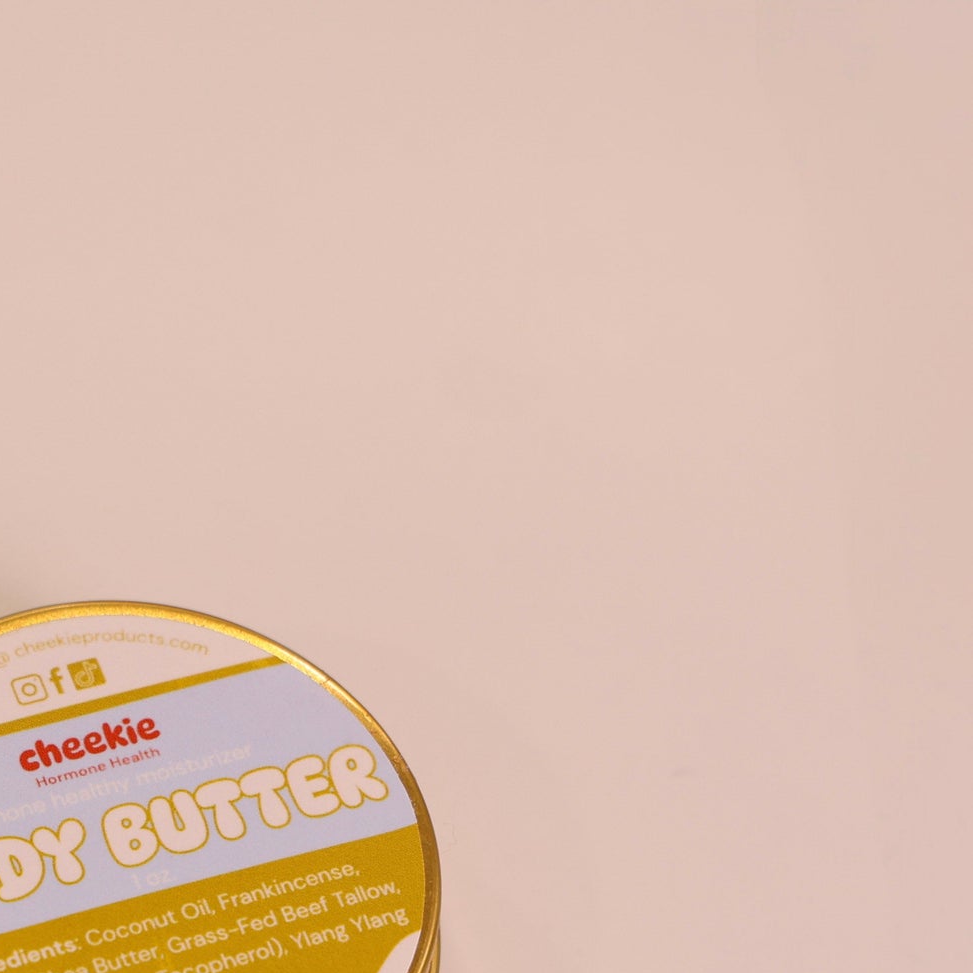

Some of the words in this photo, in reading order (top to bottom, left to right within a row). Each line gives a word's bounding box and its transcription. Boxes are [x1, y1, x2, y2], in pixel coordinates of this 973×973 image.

[13, 629, 210, 658] cheekieproducts.com
[19, 717, 162, 773] cheekie
[35, 763, 108, 788] Hormone
[110, 747, 162, 770] Health
[50, 775, 129, 808] healthy
[135, 743, 254, 787] moisturizer
[101, 743, 390, 868] BUTTER
[84, 910, 178, 946] Coconut
[181, 897, 216, 921] Oil,
[217, 863, 361, 911] Frankincense,
[166, 910, 278, 955] Grass-Fed
[280, 896, 330, 923] Beef
[331, 881, 402, 909] Tallow,
[290, 924, 349, 951] Ylang
[350, 908, 410, 933] Ylang
